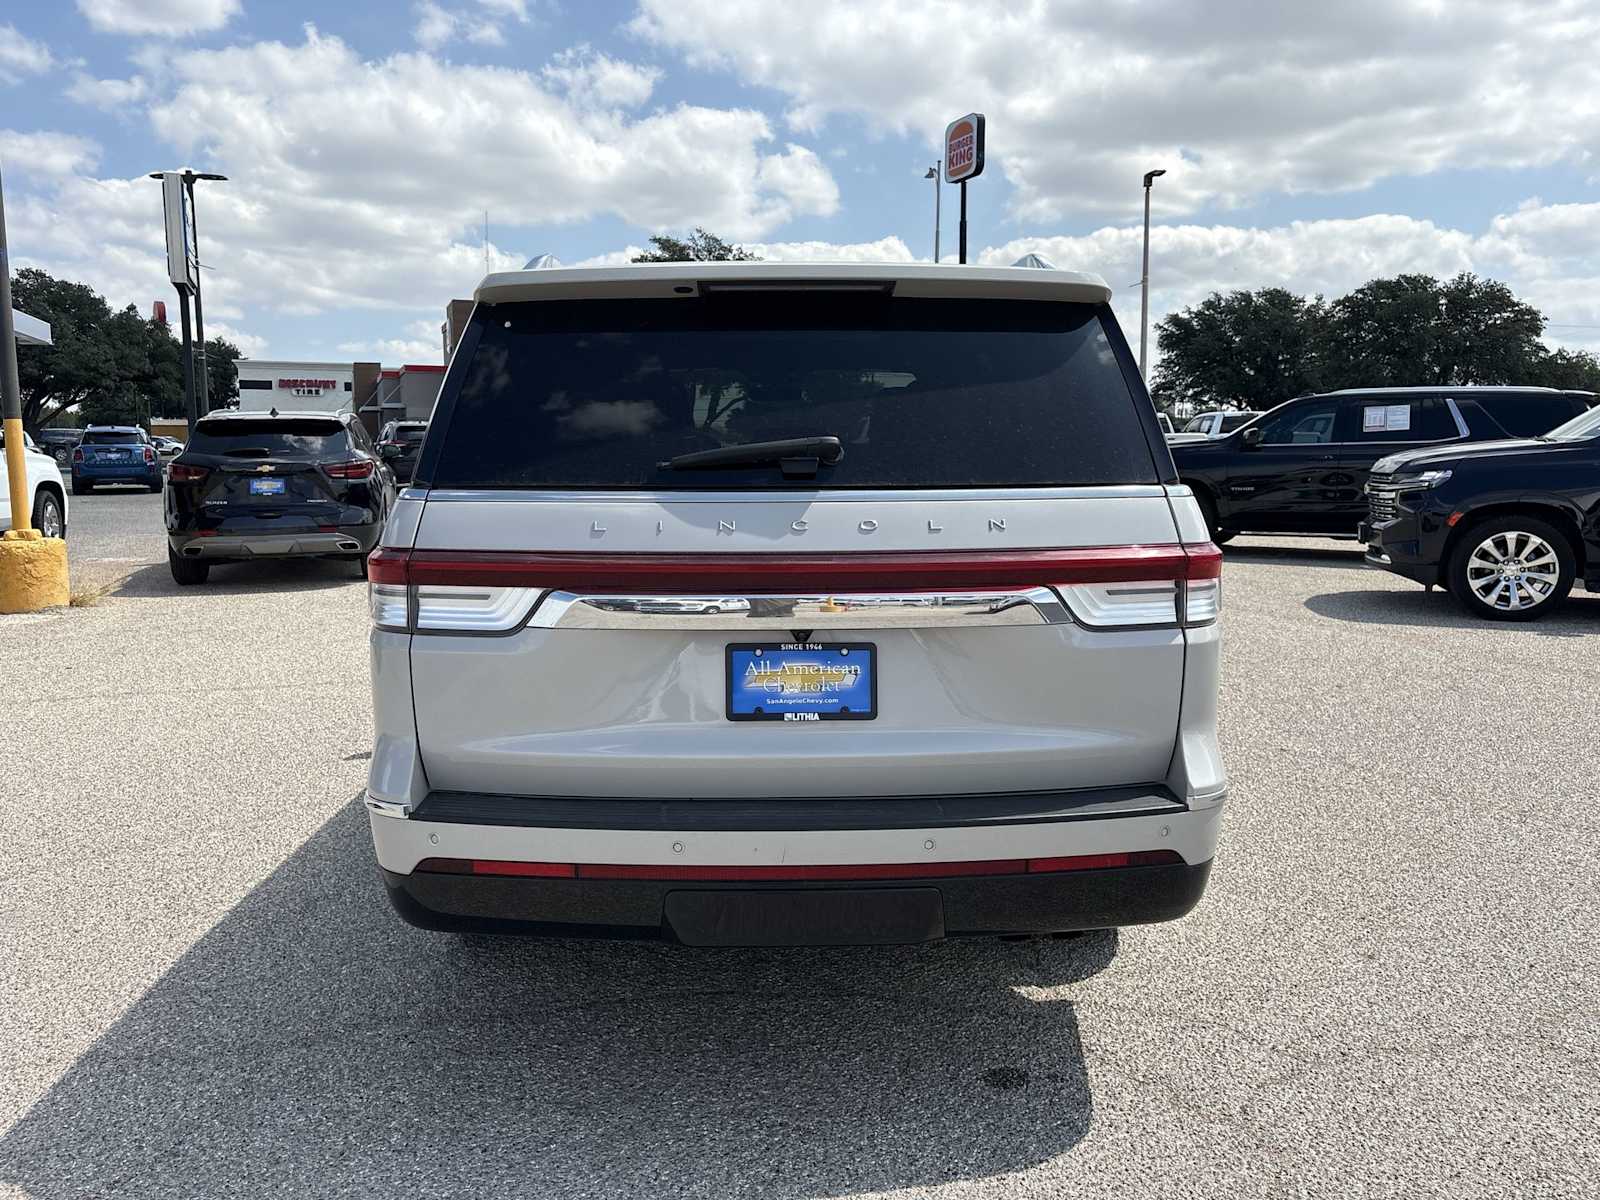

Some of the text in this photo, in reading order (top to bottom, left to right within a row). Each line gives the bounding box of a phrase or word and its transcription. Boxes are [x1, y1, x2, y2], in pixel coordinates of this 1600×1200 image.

[949, 146, 973, 169] KING
[591, 518, 1006, 533] LINCOLN
[744, 660, 862, 676] All American
[763, 676, 841, 694] Chevrolet
[792, 712, 820, 721] LITHIA
